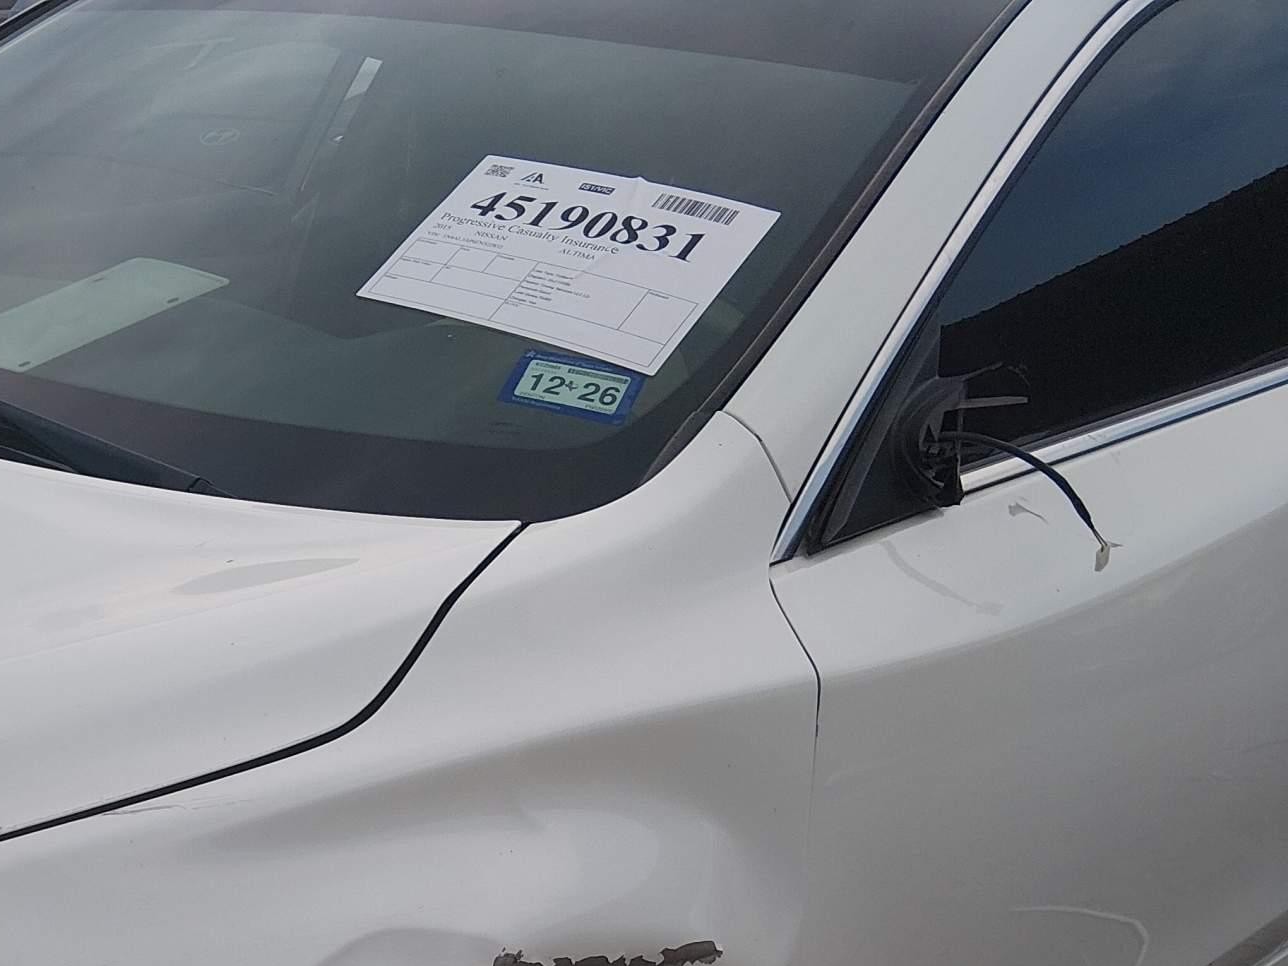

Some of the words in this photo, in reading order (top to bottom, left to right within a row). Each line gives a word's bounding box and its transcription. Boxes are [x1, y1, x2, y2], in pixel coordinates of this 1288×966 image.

[440, 212, 506, 231] Progressive
[508, 224, 559, 242] Casualty
[561, 235, 620, 254] Insurance
[471, 191, 706, 262] 45190831
[531, 373, 566, 396] 12
[577, 382, 621, 406] 26
